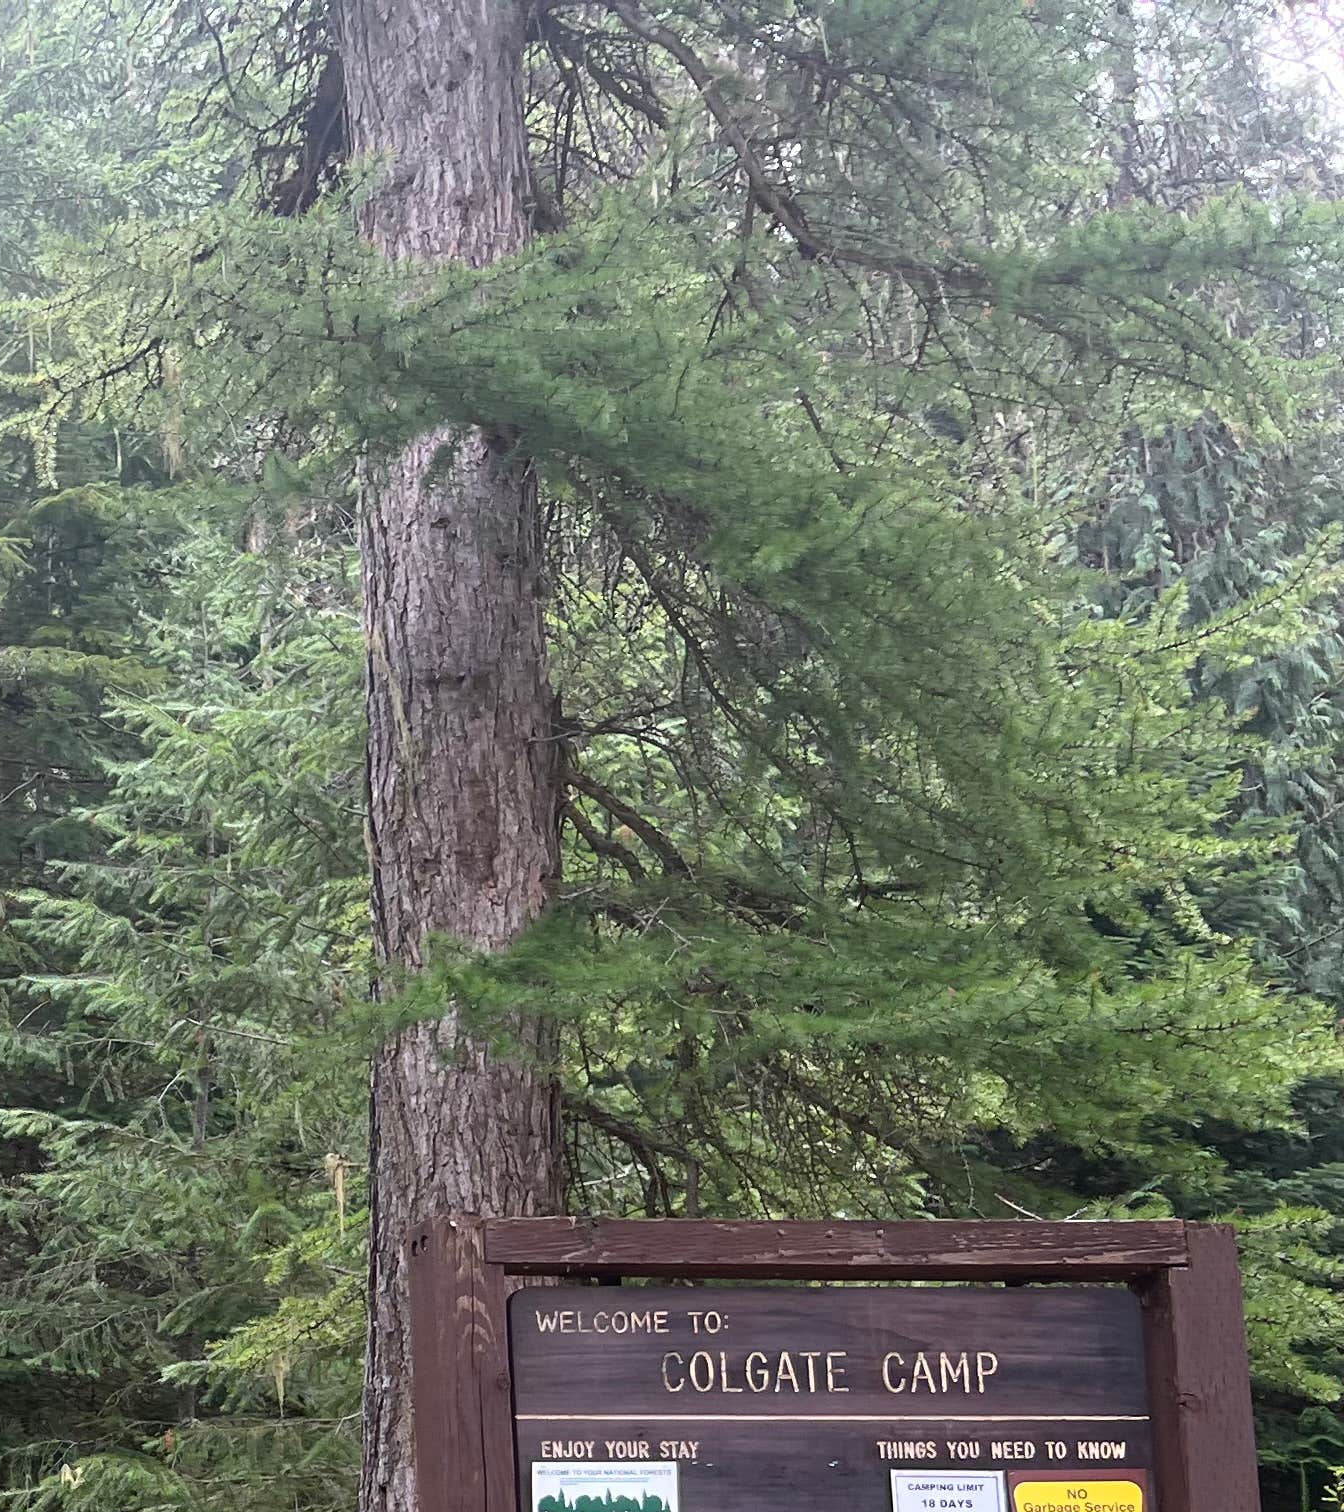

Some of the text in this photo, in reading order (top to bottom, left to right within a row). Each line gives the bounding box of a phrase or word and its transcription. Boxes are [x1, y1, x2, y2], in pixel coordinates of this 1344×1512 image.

[535, 1309, 729, 1334] WELCOME TO:
[662, 1350, 999, 1394] COLGATE CAMP
[540, 1440, 700, 1460] ENJOY YOUR STAY
[876, 1440, 1127, 1460] THINGS YOU NEED TO KNOW
[907, 1483, 985, 1491] CAMPING LIMIT
[1066, 1488, 1088, 1500] NO
[921, 1499, 973, 1509] 18 DAYS
[1084, 1501, 1135, 1512] Service
